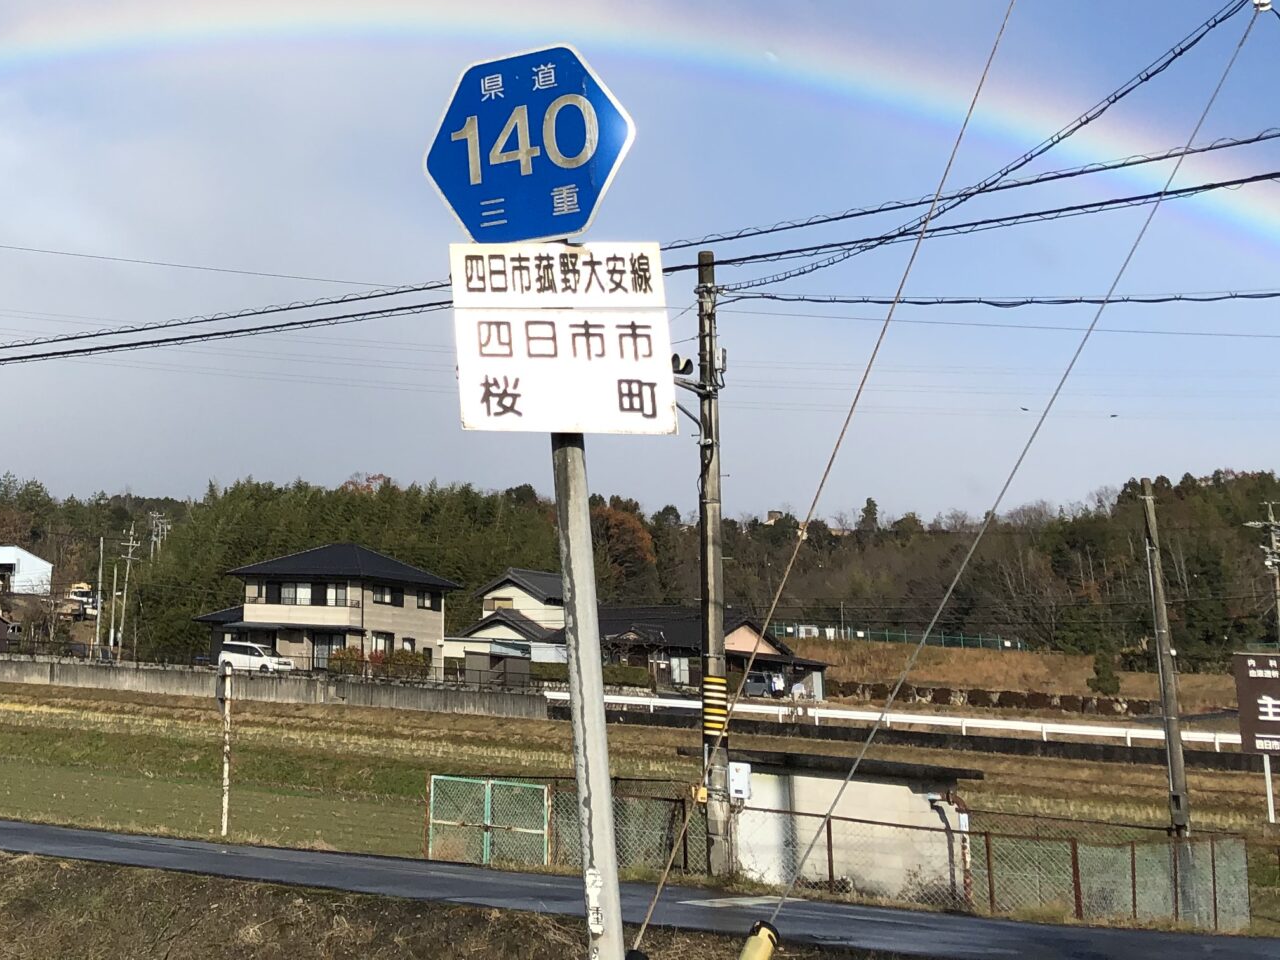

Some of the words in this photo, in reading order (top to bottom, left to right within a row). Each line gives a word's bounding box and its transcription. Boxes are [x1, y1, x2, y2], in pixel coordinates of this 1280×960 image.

[480, 63, 558, 102] 県道
[450, 93, 600, 185] 140
[480, 184, 581, 228] 三重
[477, 320, 654, 362] 四日市市
[480, 374, 658, 420] 桜町
